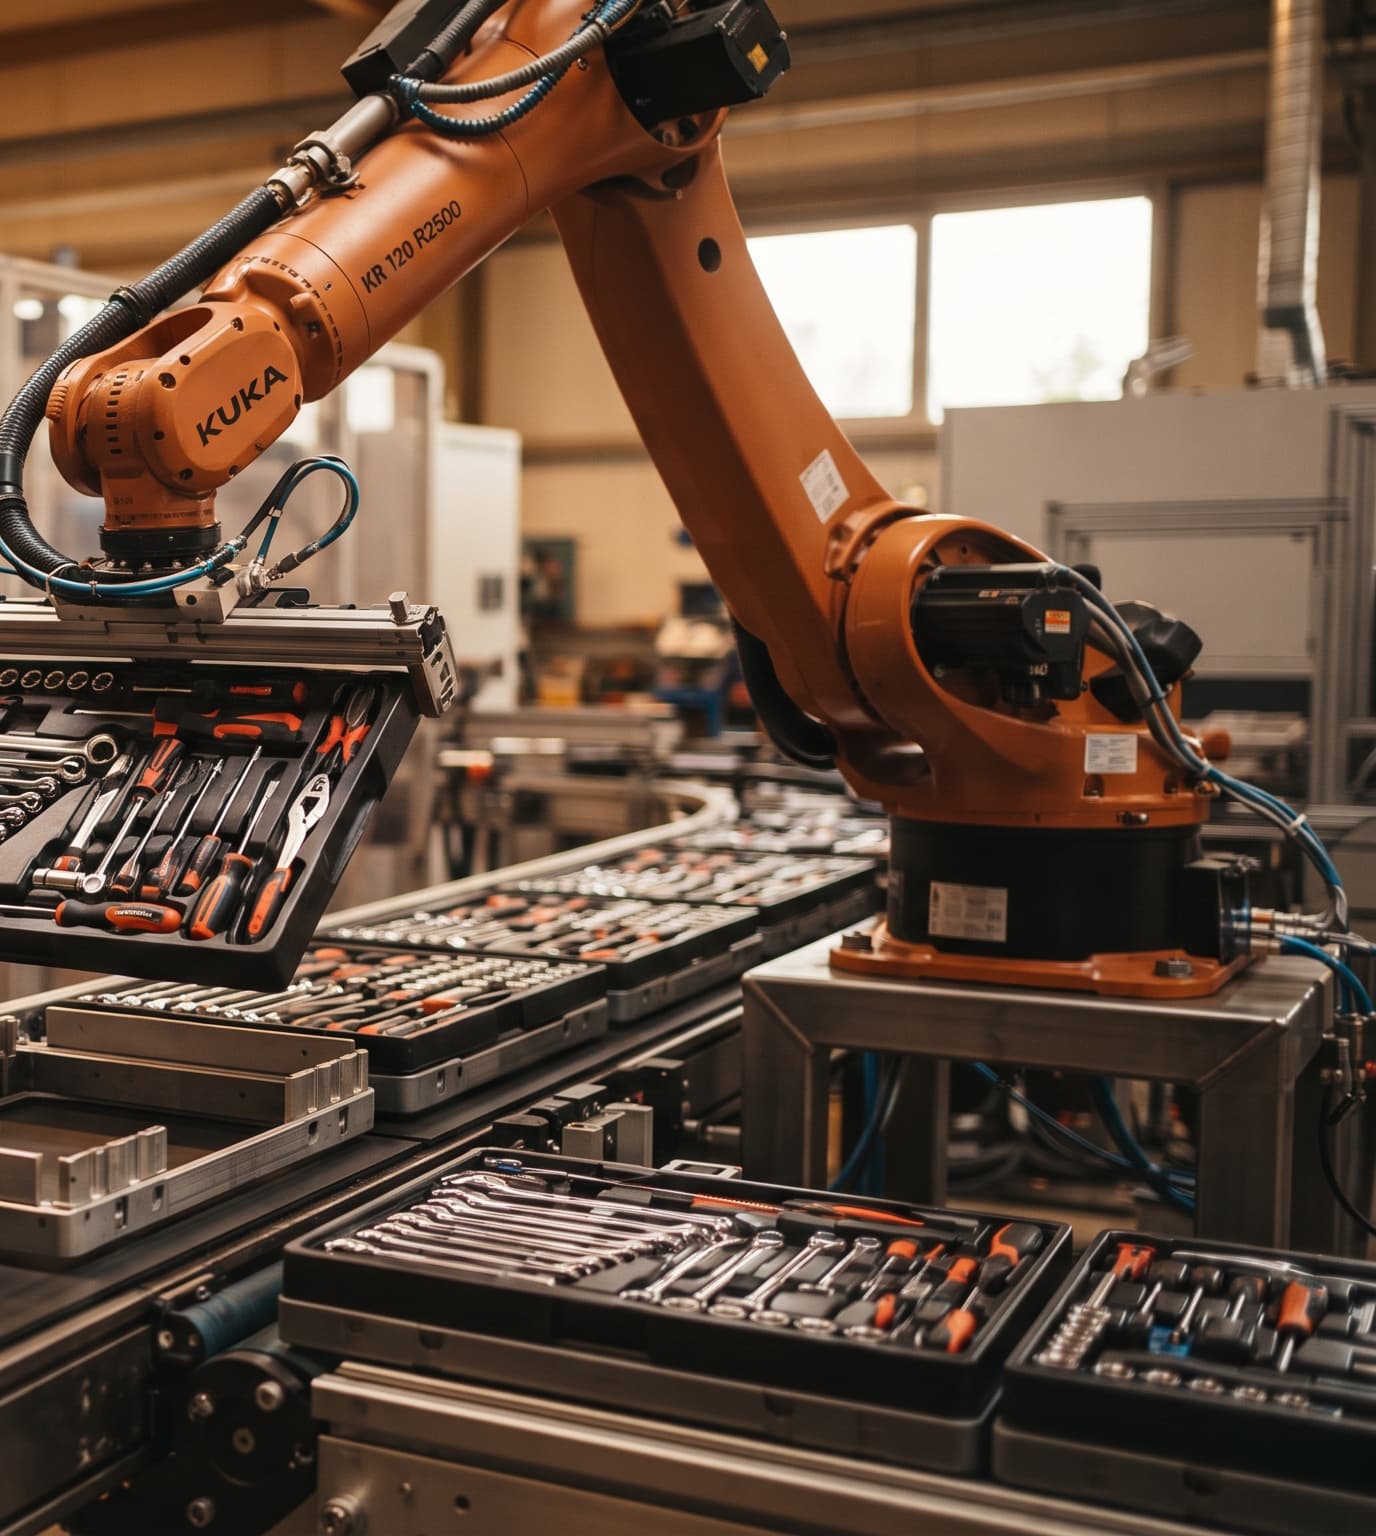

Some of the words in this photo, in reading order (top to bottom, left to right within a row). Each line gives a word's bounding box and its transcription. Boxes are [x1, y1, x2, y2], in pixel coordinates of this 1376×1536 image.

[361, 264, 388, 294] KR
[386, 241, 415, 271] 120
[413, 200, 462, 249] R2500
[196, 366, 288, 446] KUKA
